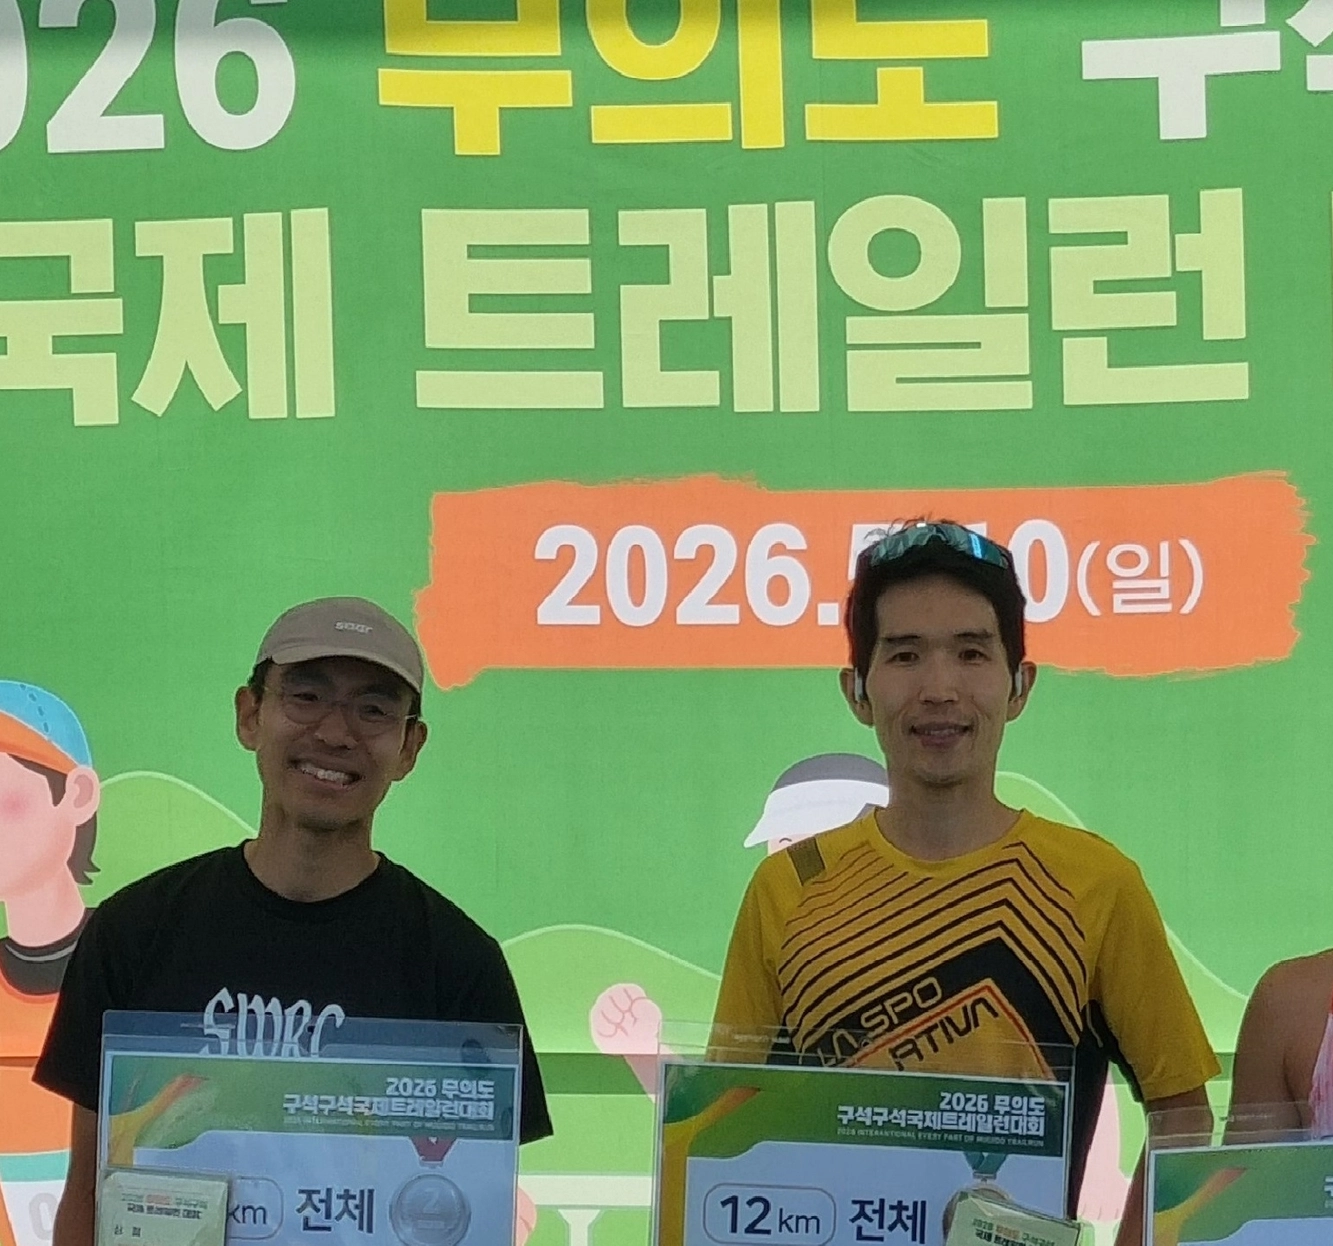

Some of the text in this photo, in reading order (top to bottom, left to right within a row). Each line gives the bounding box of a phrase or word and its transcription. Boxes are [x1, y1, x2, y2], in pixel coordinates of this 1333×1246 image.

[0, 207, 336, 427] 국제
[415, 187, 1250, 412] 트레일런
[385, 1077, 495, 1100] 2026 무의도
[939, 1092, 1046, 1117] 2026 무의도
[837, 1105, 1046, 1138] 구석구석국제트레일런대회
[296, 1187, 375, 1234] 전체
[719, 1195, 927, 1245] 12 km 전체
